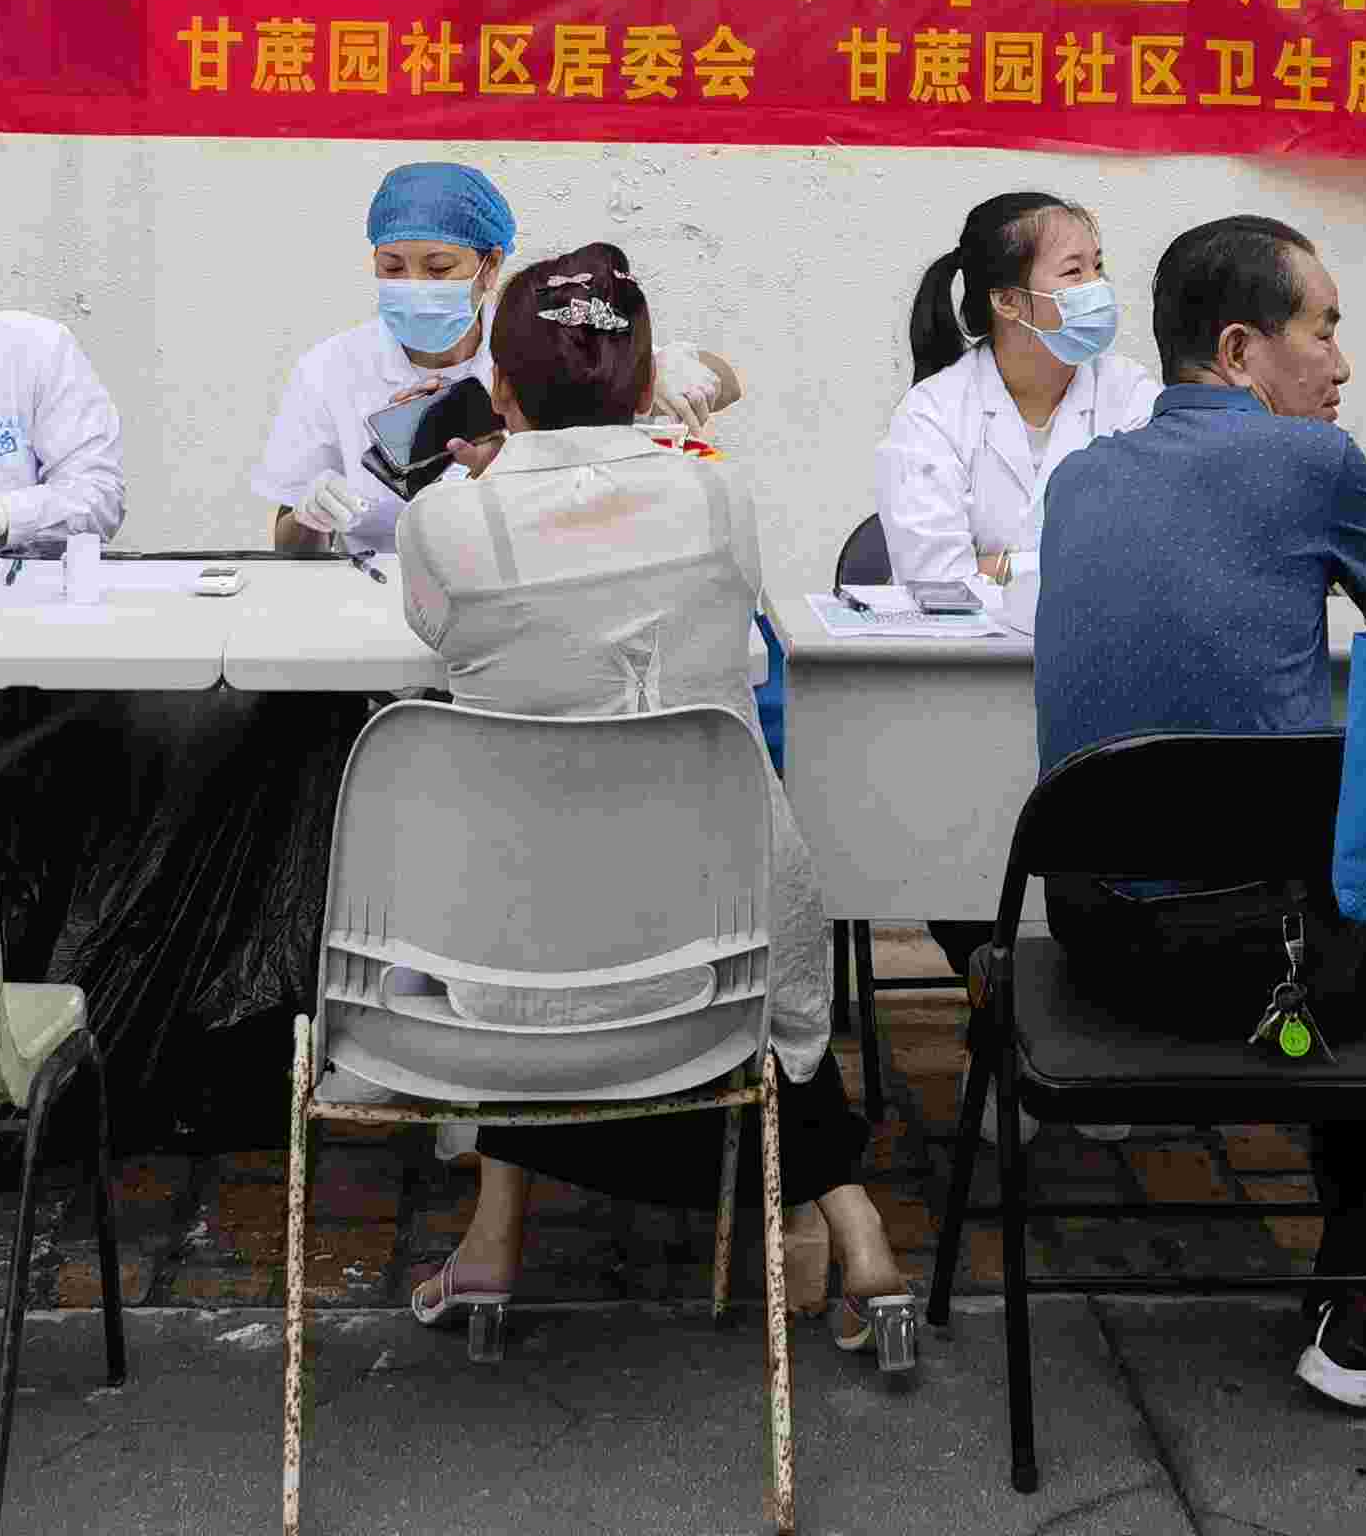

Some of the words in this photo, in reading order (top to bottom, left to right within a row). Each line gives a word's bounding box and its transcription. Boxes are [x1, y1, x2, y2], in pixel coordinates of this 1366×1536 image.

[176, 15, 757, 101] 甘蔗园社区居委会
